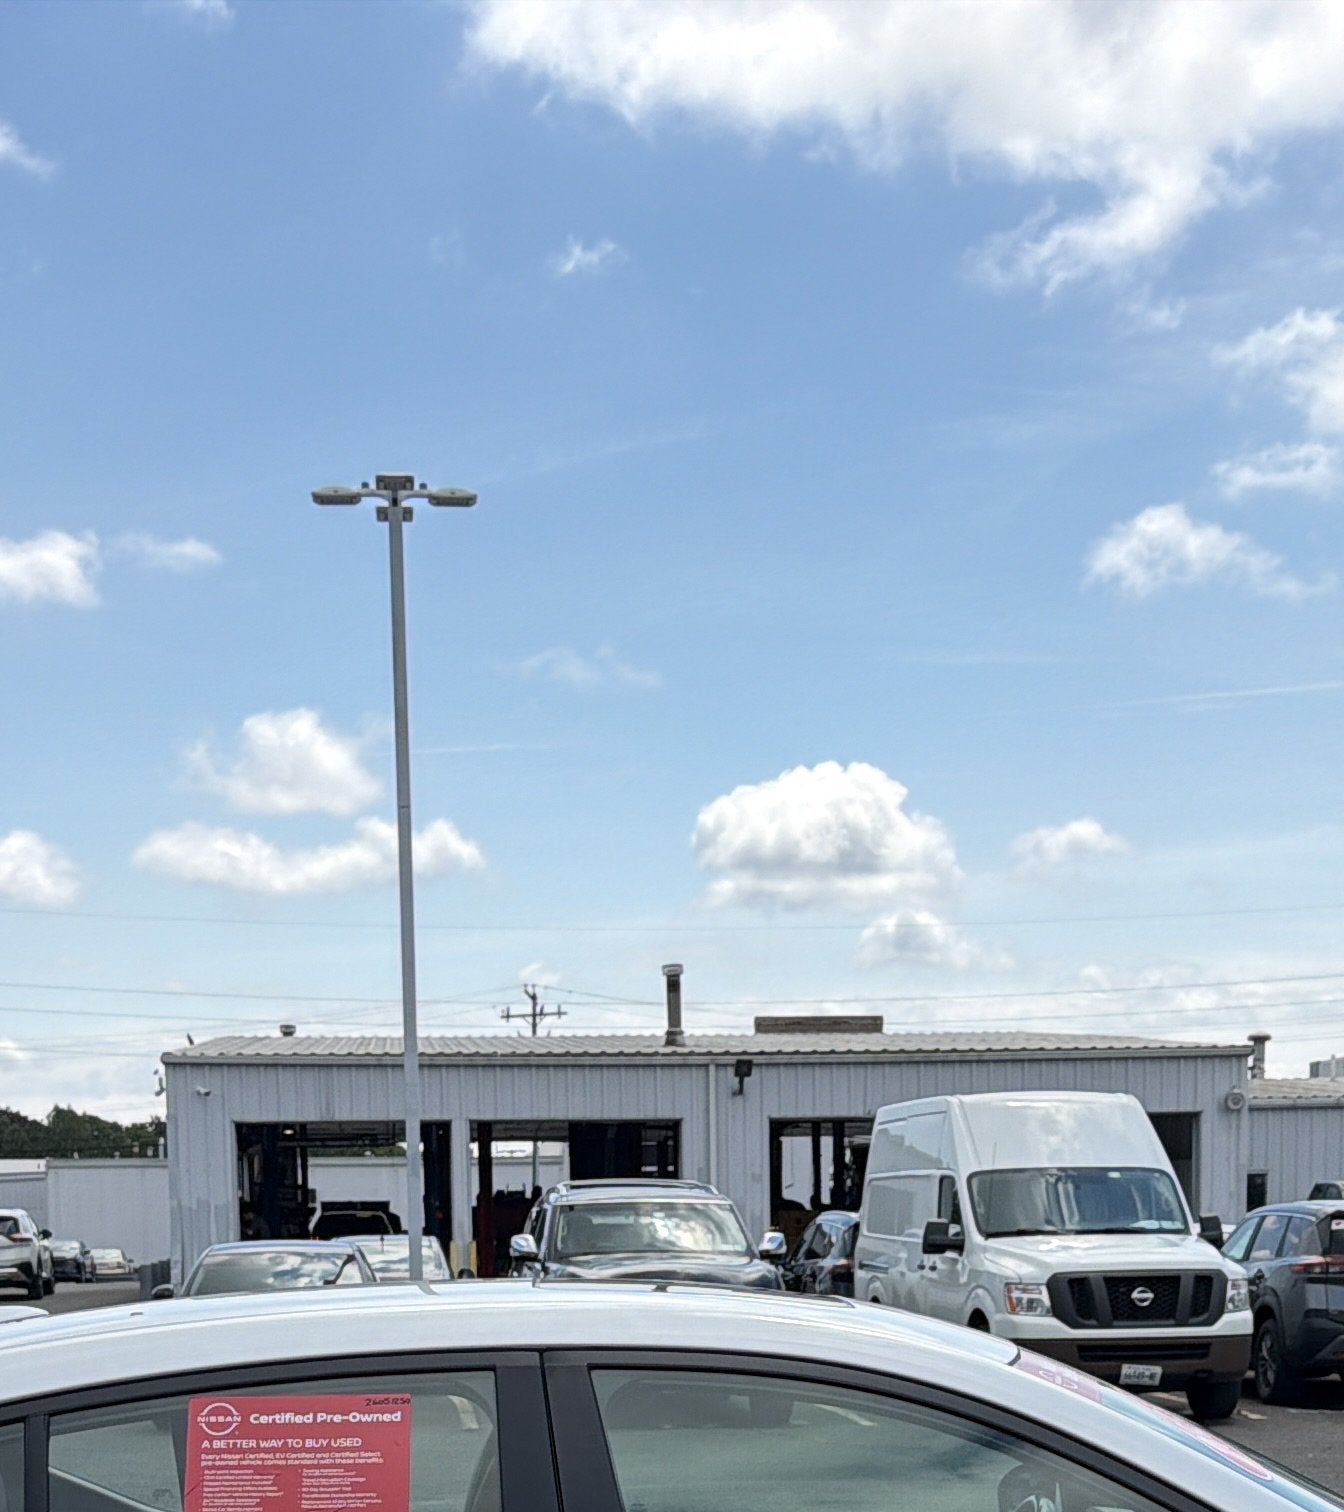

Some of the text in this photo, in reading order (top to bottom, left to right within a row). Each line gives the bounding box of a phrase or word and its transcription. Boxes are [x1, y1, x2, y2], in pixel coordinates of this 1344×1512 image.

[196, 1415, 242, 1423] NISSAN
[249, 1410, 402, 1424] Certified Pre-Owned
[201, 1437, 362, 1449] A BETTER WAY TO BUY USED
